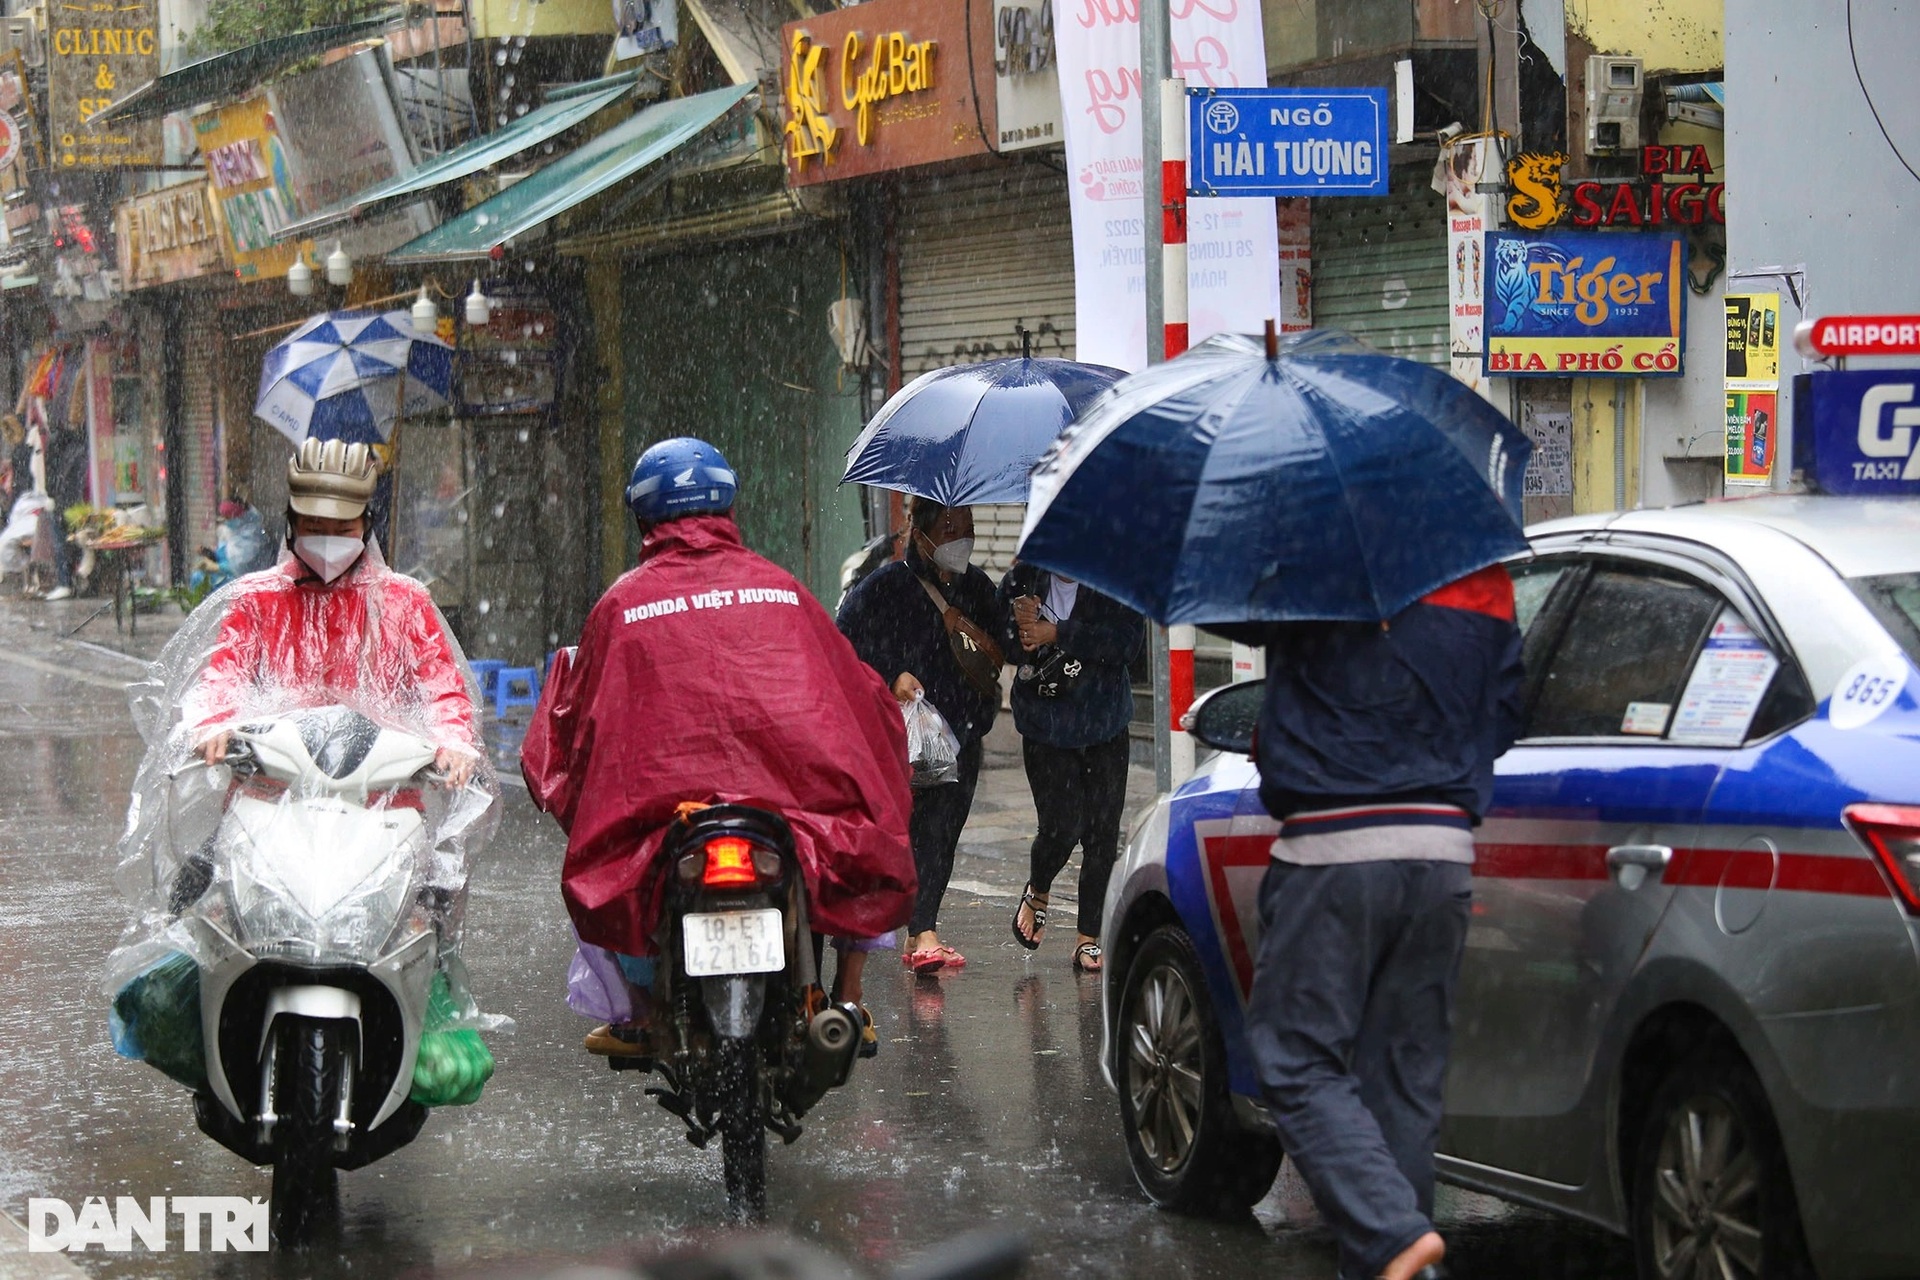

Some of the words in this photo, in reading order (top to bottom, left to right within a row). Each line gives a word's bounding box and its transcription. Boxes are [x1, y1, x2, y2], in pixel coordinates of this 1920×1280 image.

[55, 28, 153, 55] CLINIC
[95, 63, 115, 90] &
[1270, 103, 1333, 126] NGÕ
[1213, 133, 1265, 176] HÀI
[1274, 138, 1372, 184] TƯỢNG
[1643, 145, 1714, 175] BIA
[1452, 219, 1471, 233] Massage
[1471, 217, 1482, 232] Body
[1527, 256, 1663, 326] Tiger
[1454, 304, 1464, 317] Foot
[1464, 303, 1482, 317] Massage
[1541, 307, 1569, 316] SINCE
[1614, 307, 1639, 316] 1932
[1489, 352, 1548, 371] BIA
[1556, 343, 1624, 371] PHỐ
[1632, 342, 1679, 371] CỔ
[1852, 461, 1900, 480] TAXI
[624, 597, 689, 624] HONDA
[691, 589, 734, 609] VIỆT
[738, 588, 800, 606] HƯƠNG
[1845, 673, 1895, 705] 865
